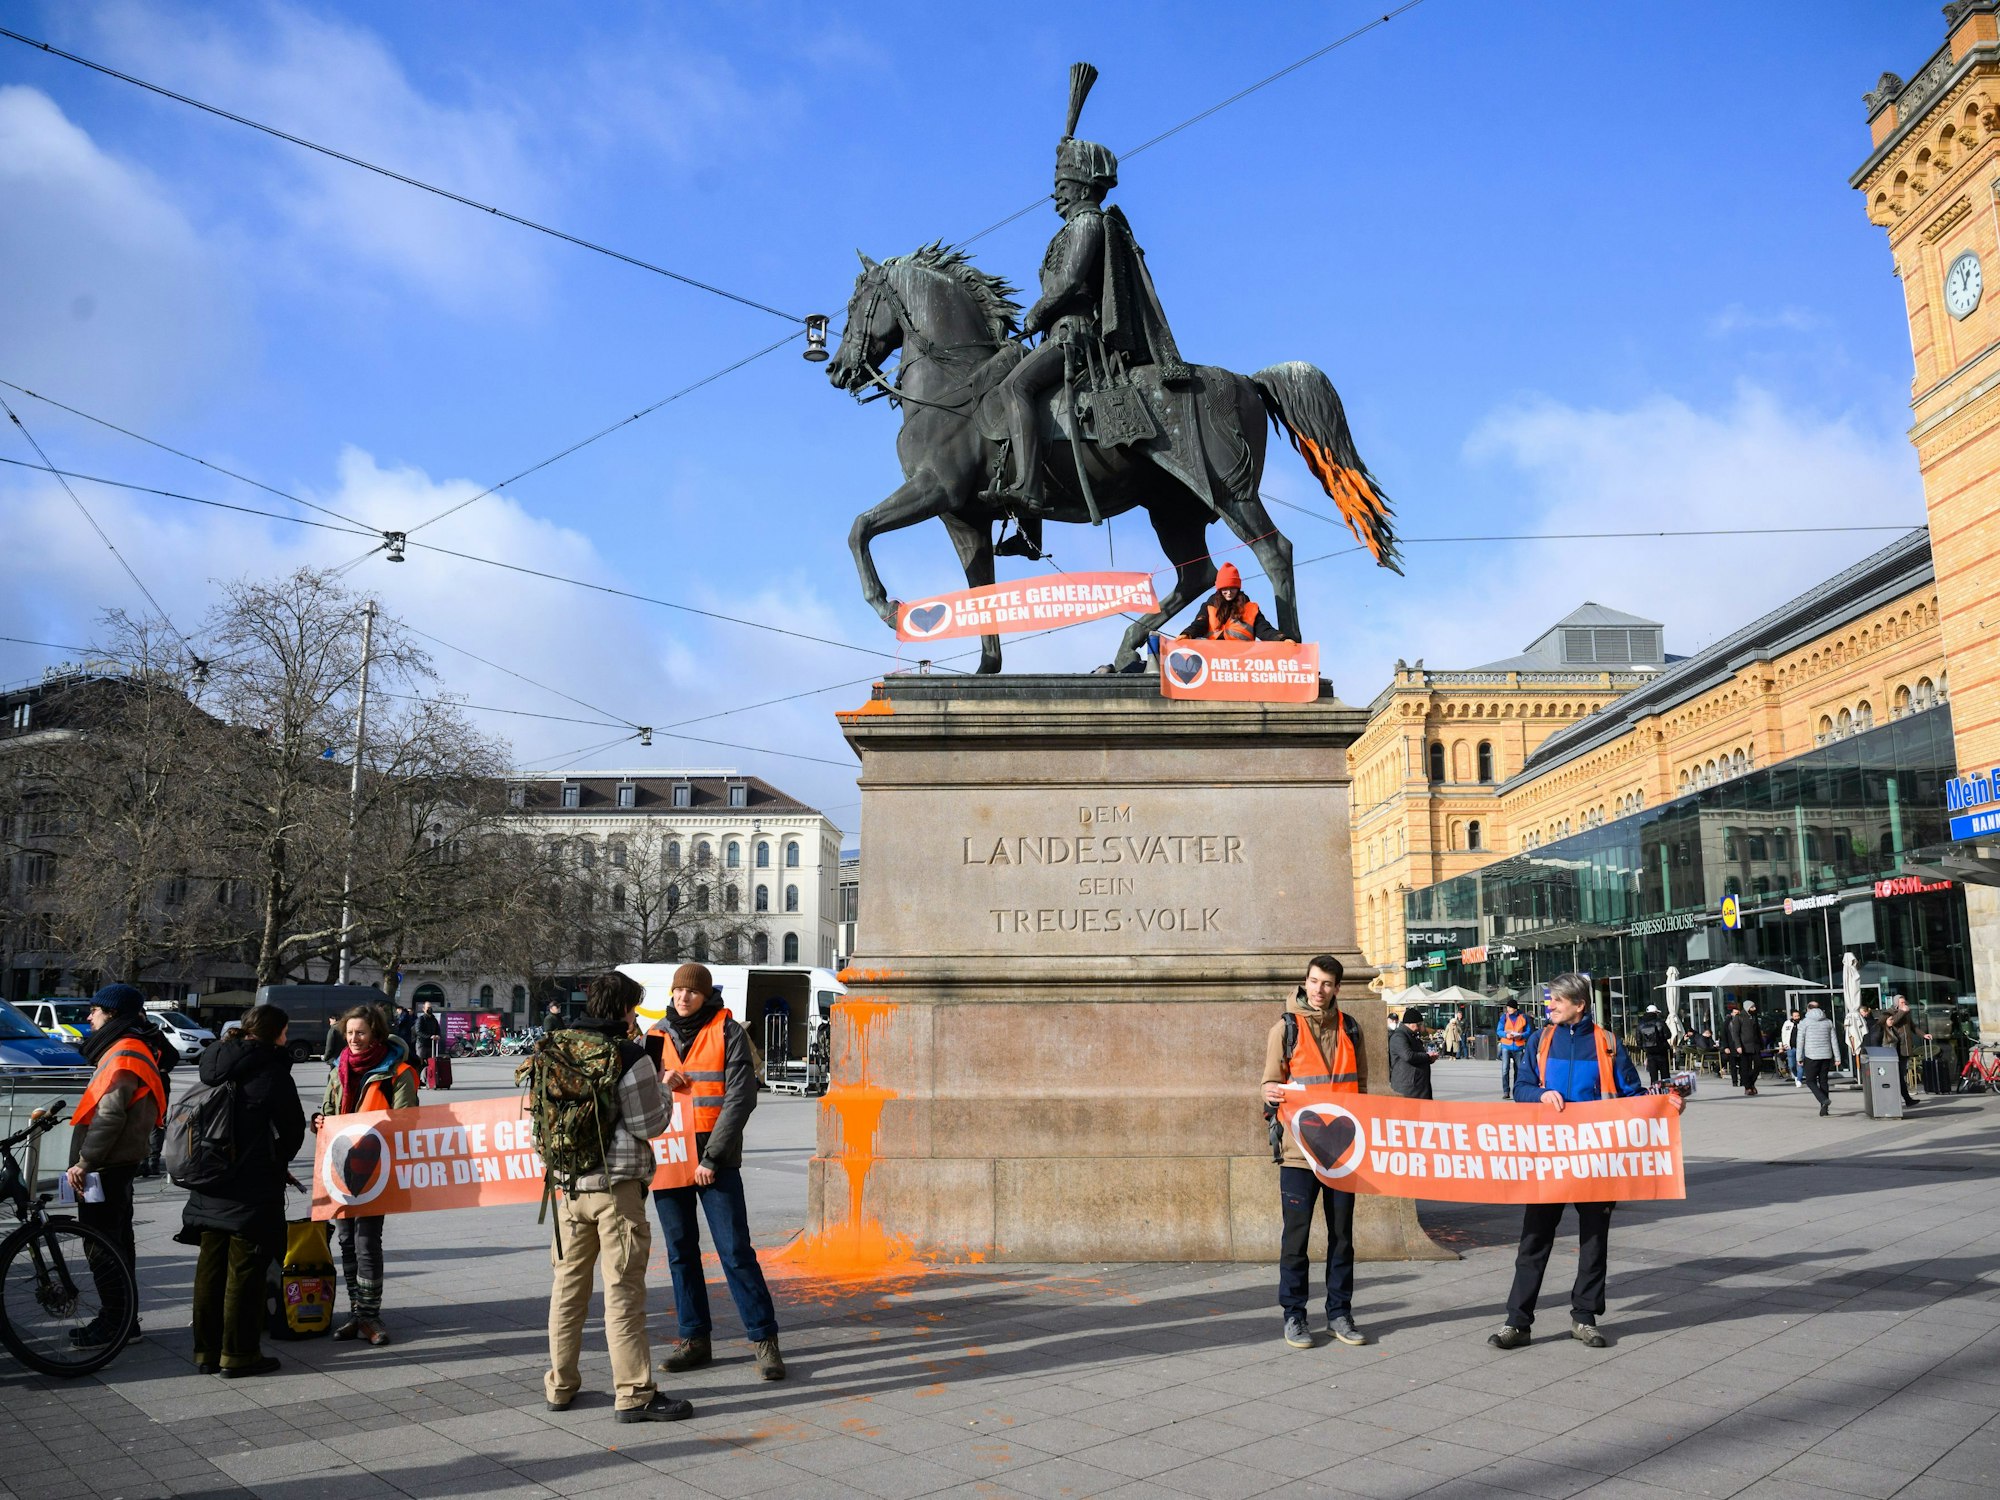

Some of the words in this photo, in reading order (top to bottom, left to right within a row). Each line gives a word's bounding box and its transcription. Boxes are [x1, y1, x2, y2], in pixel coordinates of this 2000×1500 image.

[955, 590, 1021, 613] LETZTE
[1026, 580, 1150, 603] GENERATION
[955, 611, 992, 626] VOR
[995, 606, 1029, 622] DEN
[1210, 658, 1242, 671] ART.
[1244, 659, 1274, 672] 20A
[1277, 659, 1299, 671] GG
[1211, 672, 1249, 683] LEBEN
[1251, 670, 1315, 684] SCHÜTZEN
[1946, 772, 1990, 812] Mein
[1079, 806, 1133, 824] DEM
[963, 835, 1248, 866] LANDESVATER
[1078, 877, 1135, 896] SEIN
[1631, 917, 1666, 937] ESPRESSO
[1666, 913, 1695, 932] HOUSE
[394, 1123, 488, 1160] LETZTE
[1371, 1117, 1471, 1151] LETZTE
[1477, 1117, 1670, 1153] GENERATION
[395, 1162, 448, 1190] VOR
[452, 1156, 501, 1185] DEN
[1370, 1150, 1427, 1178] VOR
[1433, 1153, 1485, 1179] DEN
[1490, 1151, 1673, 1181] KIPPPUNKTEN
